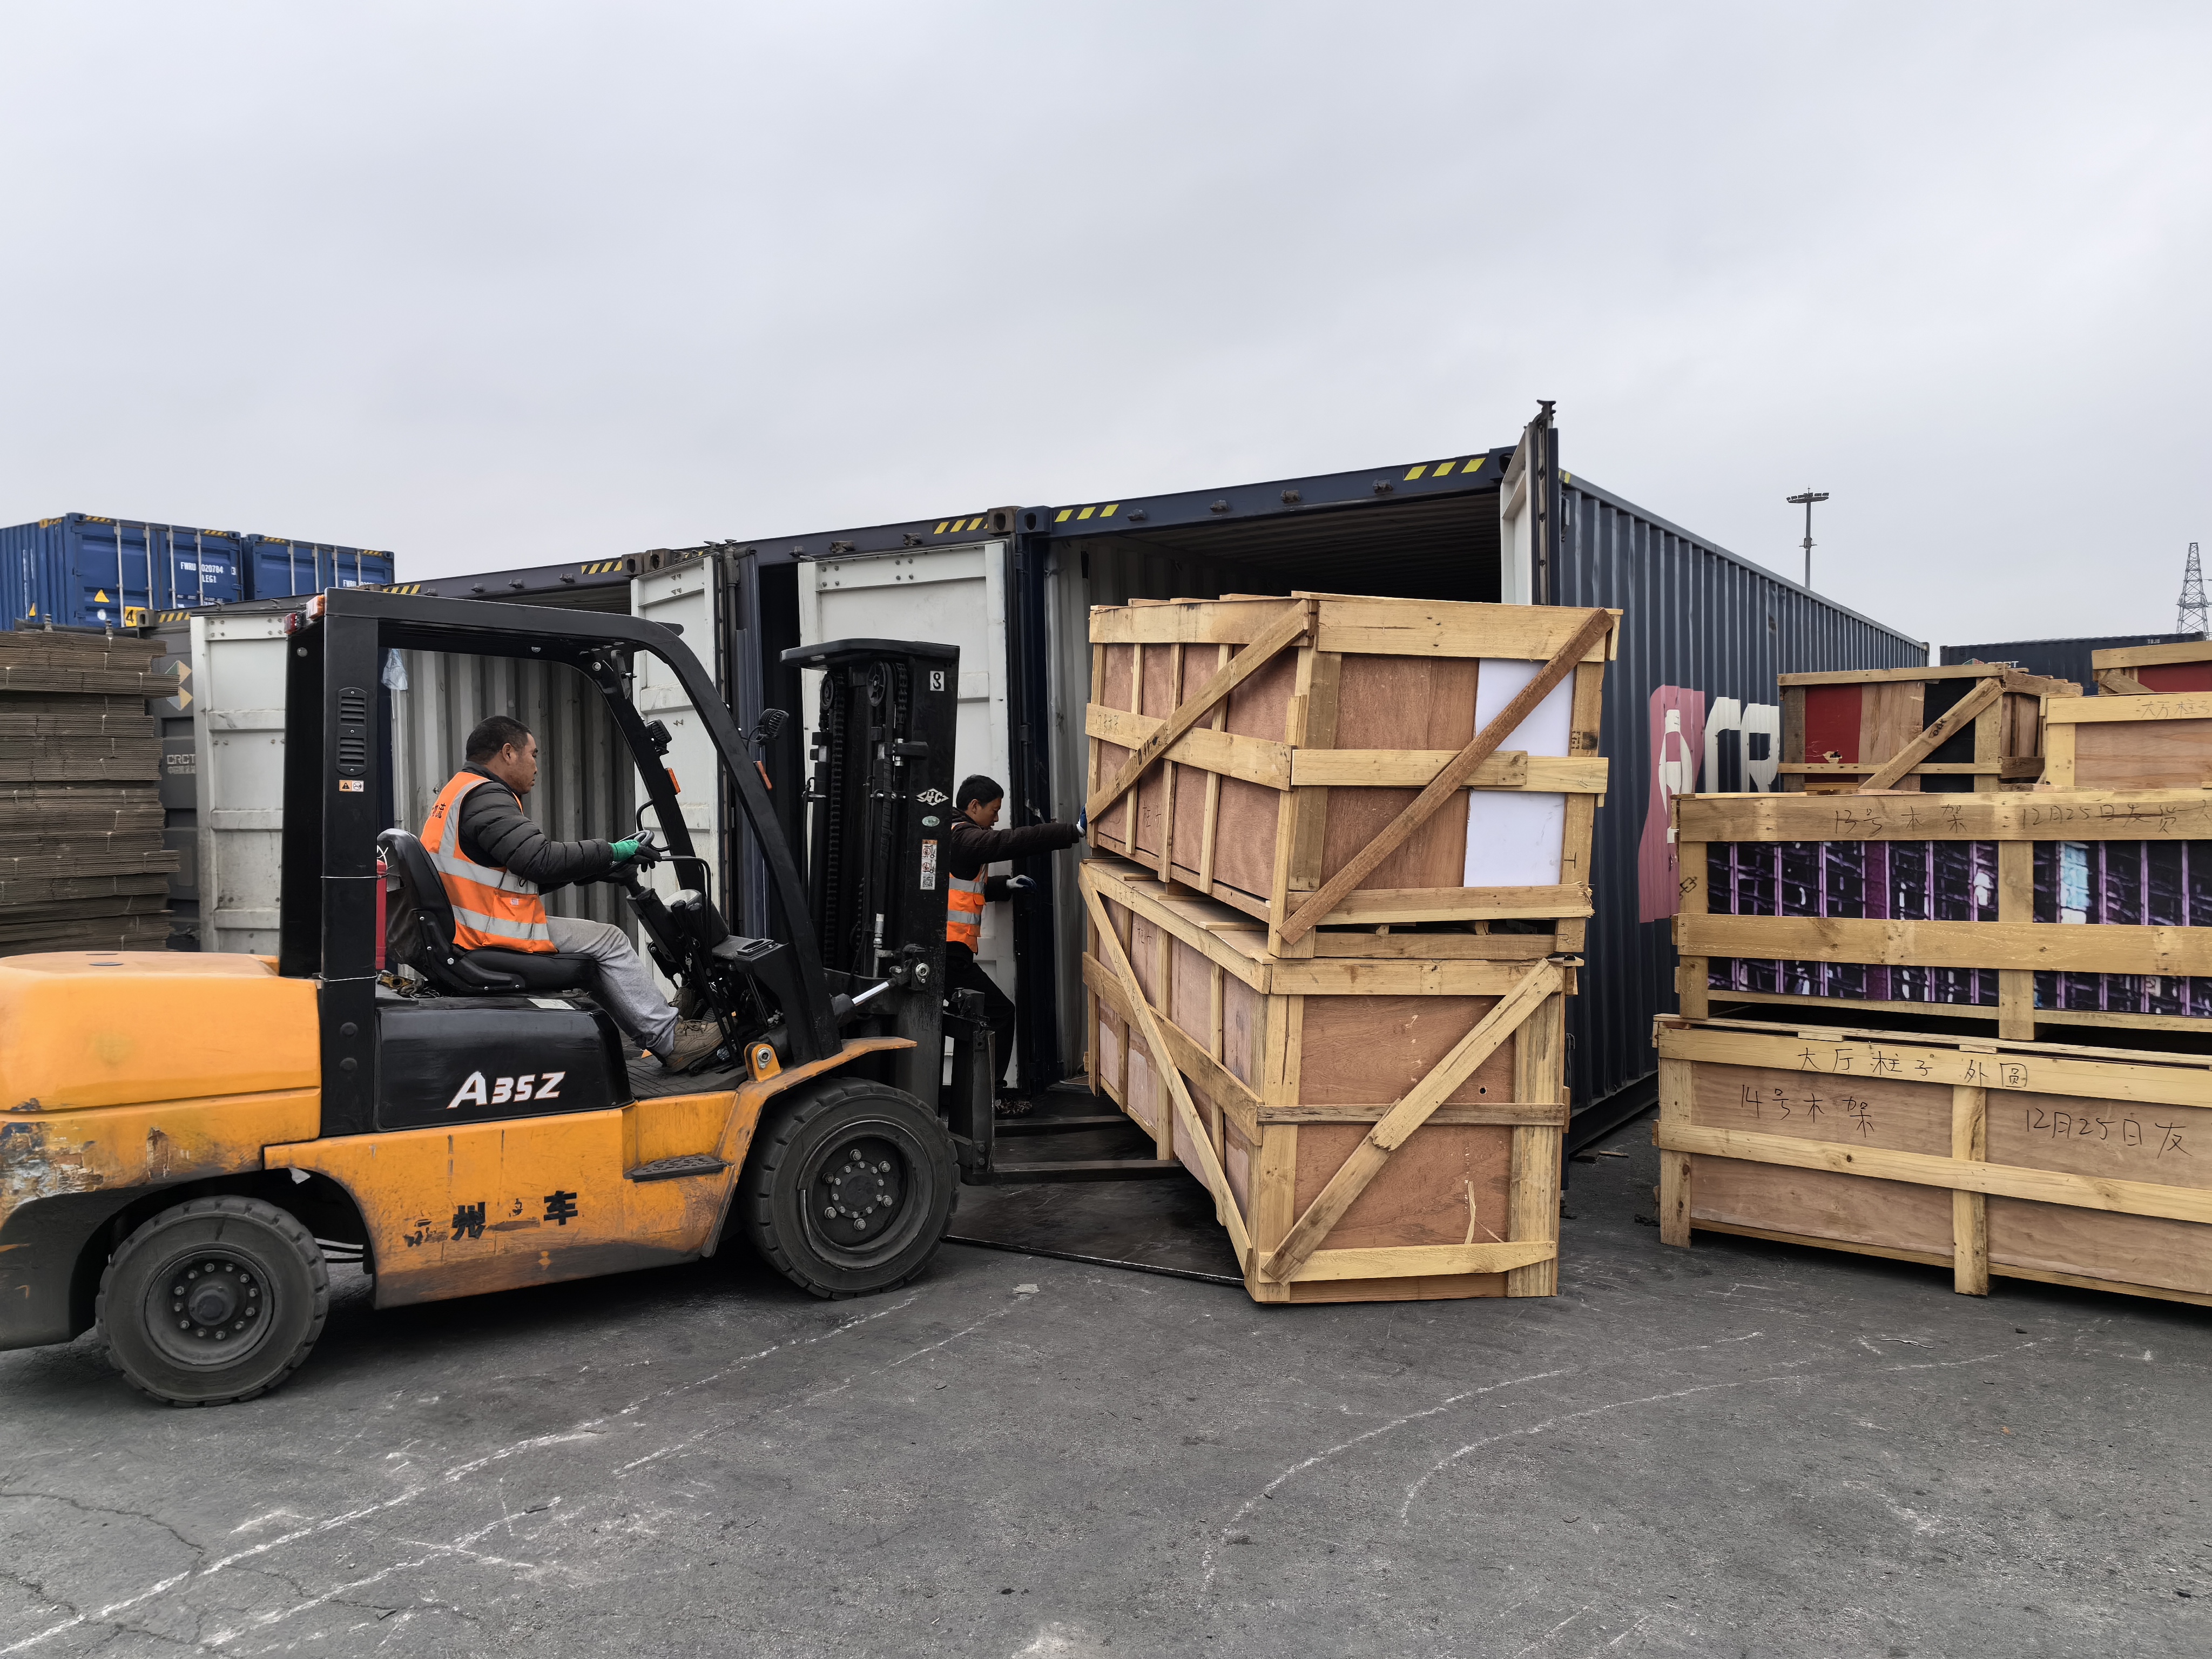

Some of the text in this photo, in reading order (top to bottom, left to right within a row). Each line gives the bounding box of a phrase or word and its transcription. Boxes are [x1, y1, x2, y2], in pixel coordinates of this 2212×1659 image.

[180, 562, 237, 575] FWRU 020784 3
[1741, 1084, 1875, 1138] 14号木架
